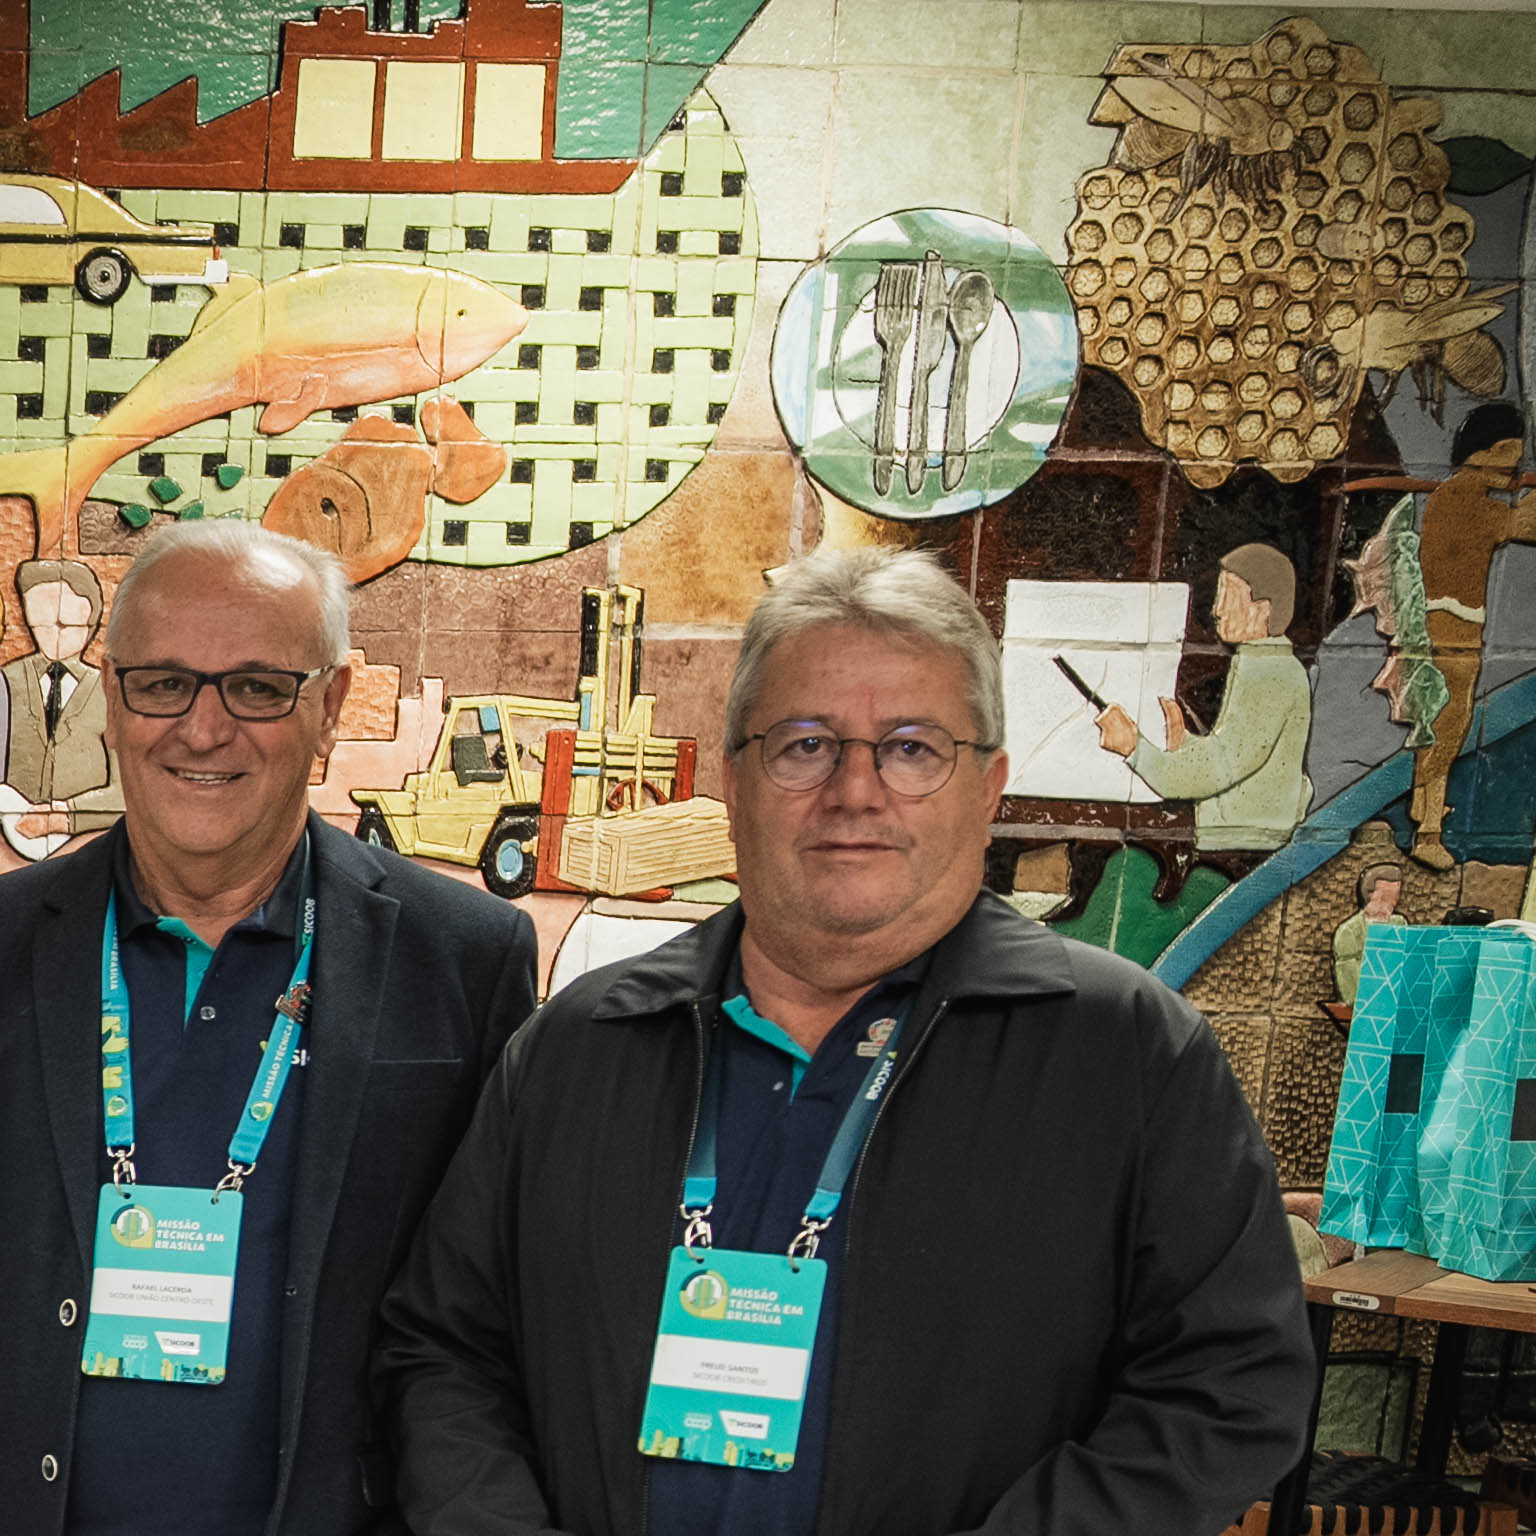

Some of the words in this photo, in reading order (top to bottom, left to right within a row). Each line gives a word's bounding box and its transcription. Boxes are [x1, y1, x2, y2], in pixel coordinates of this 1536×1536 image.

[304, 898, 316, 936] SICOOB
[261, 1062, 281, 1099] MISSÃO
[157, 1218, 200, 1232] MISSÃO
[205, 1233, 225, 1243] EM
[154, 1240, 206, 1252] BRASÍLIA
[132, 1283, 158, 1292] RAFAEL
[159, 1285, 192, 1293] LACERDA
[730, 1287, 779, 1301] MISSÃO
[782, 1305, 804, 1316] EM
[725, 1312, 783, 1326] BRASÍLIA
